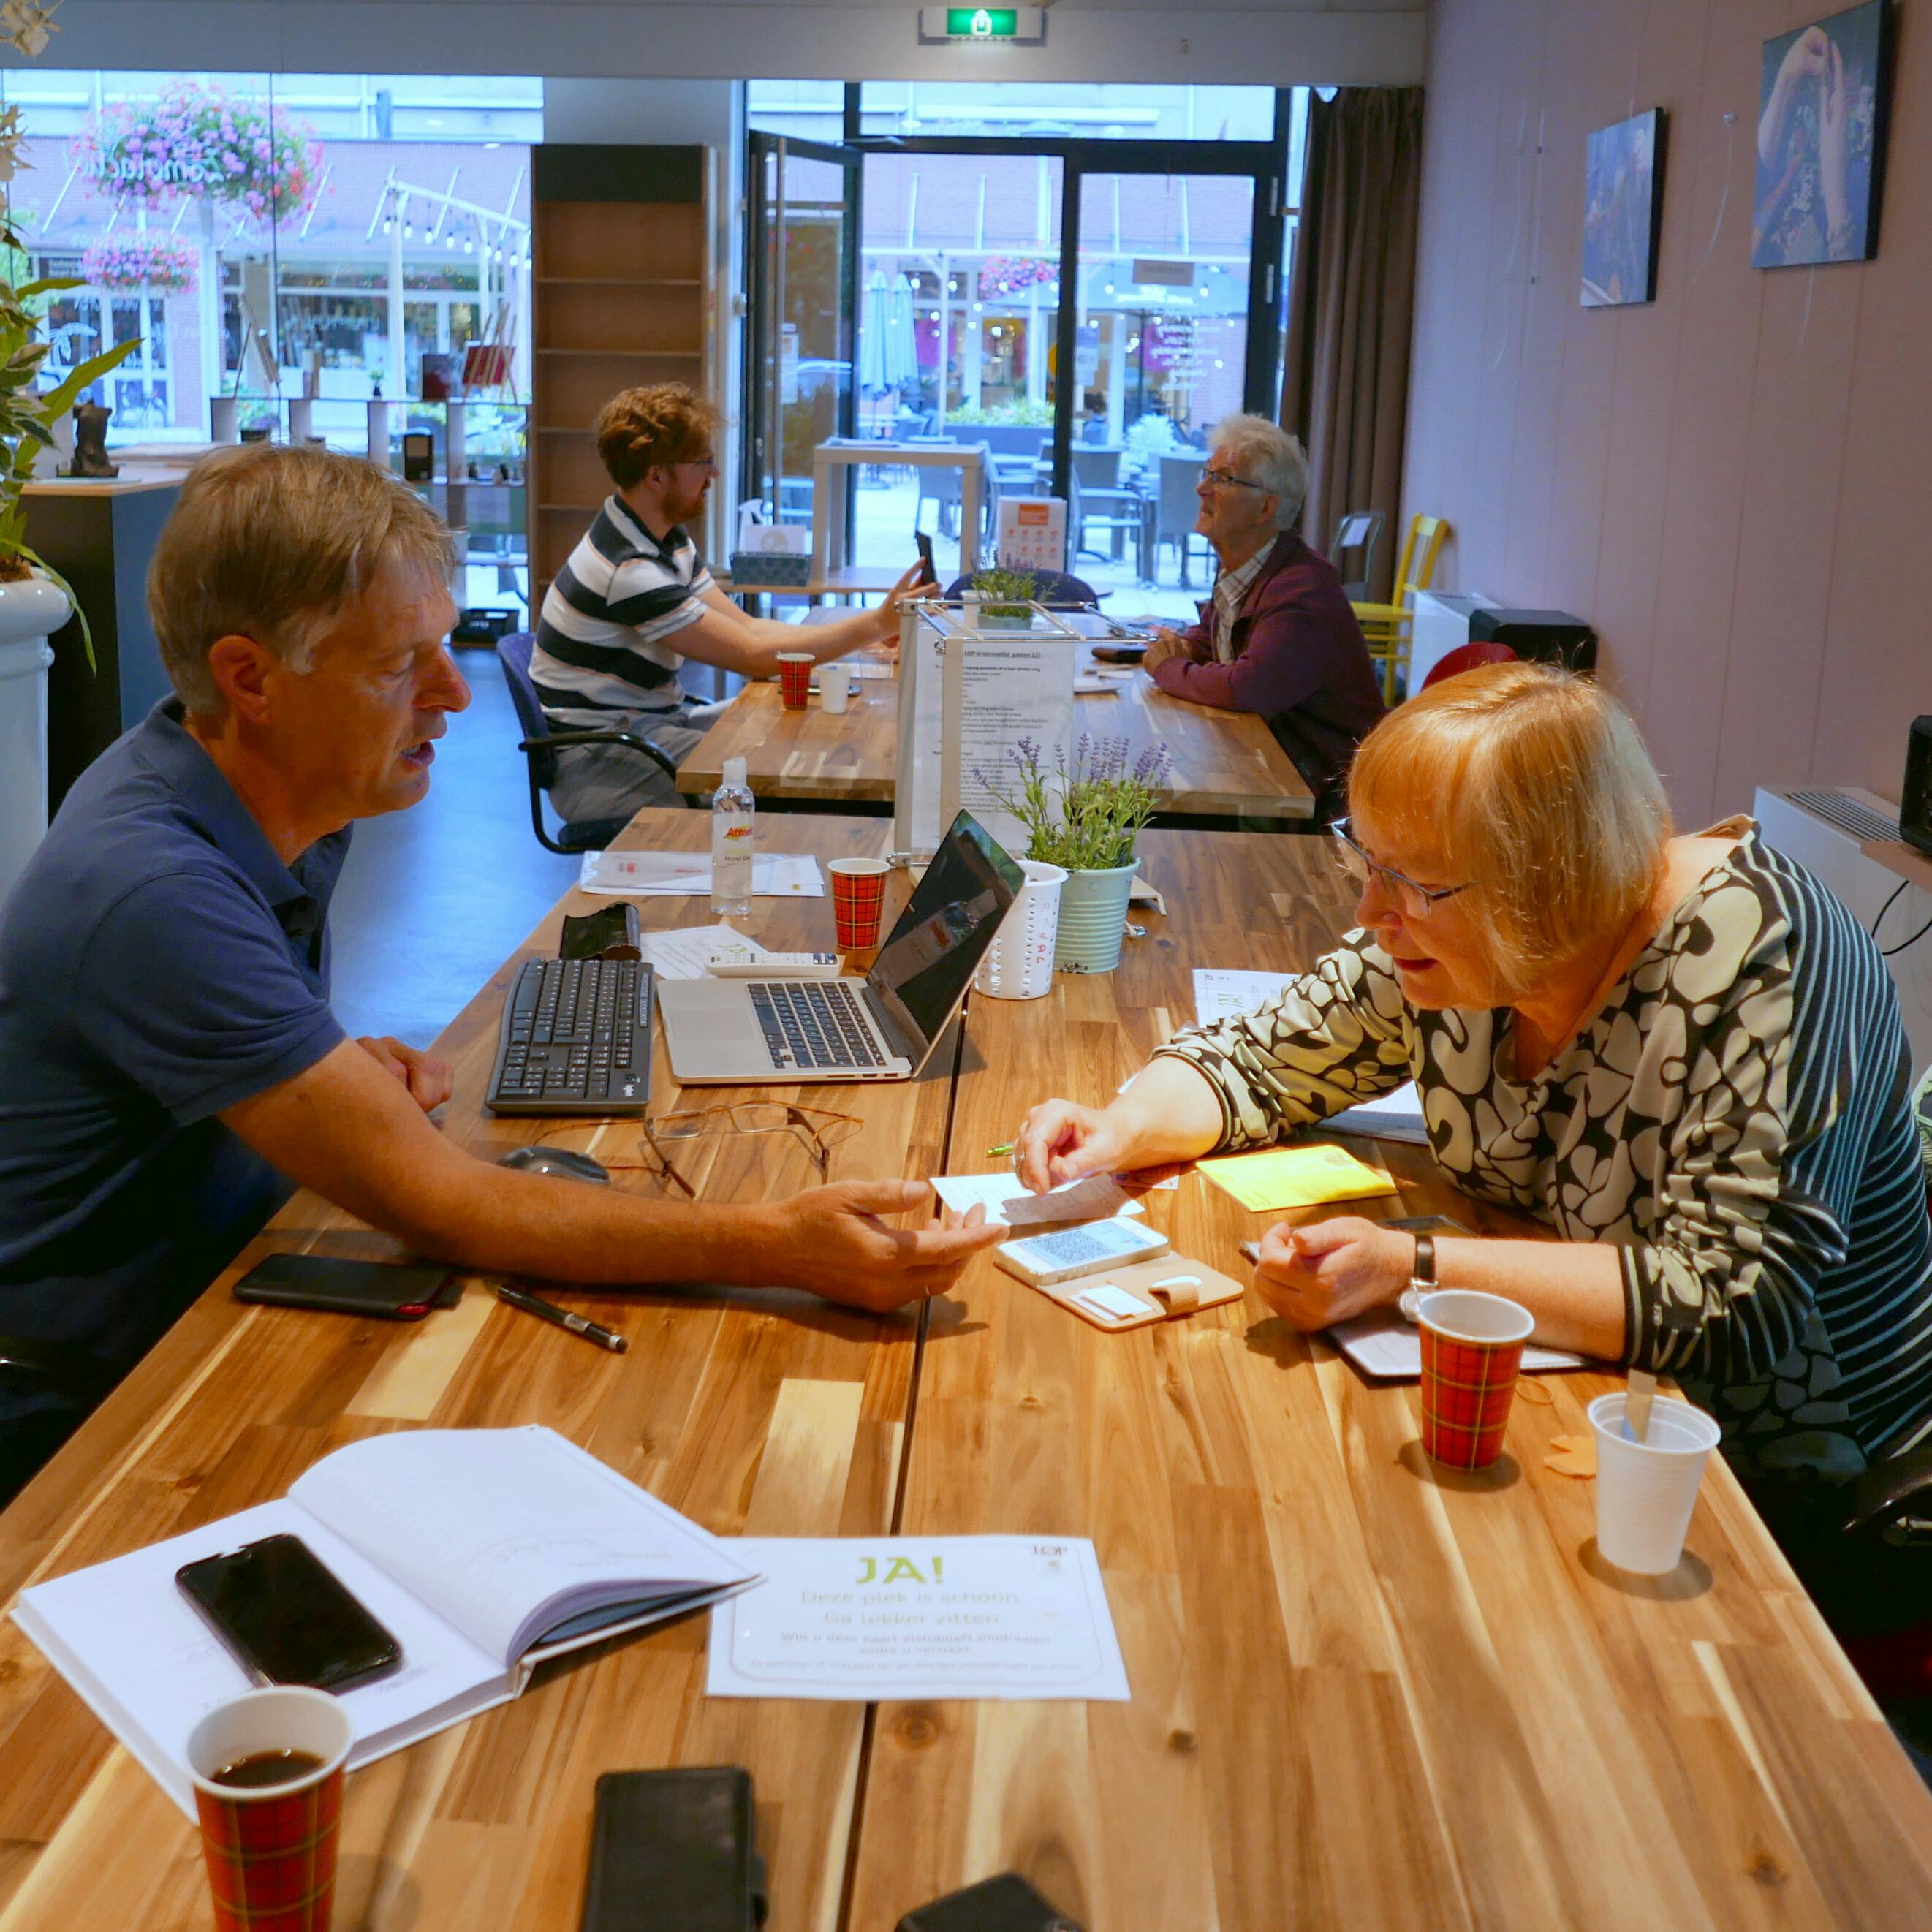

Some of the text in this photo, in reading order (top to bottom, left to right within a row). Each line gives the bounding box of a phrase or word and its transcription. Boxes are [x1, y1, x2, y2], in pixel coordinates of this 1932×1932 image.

[855, 1555, 944, 1585] JA!
[801, 1590, 854, 1603] Deze
[863, 1590, 907, 1606] plek
[917, 1590, 932, 1603] is
[823, 1611, 852, 1625] Ga
[860, 1611, 925, 1625] lekker
[826, 1632, 858, 1643] deze
